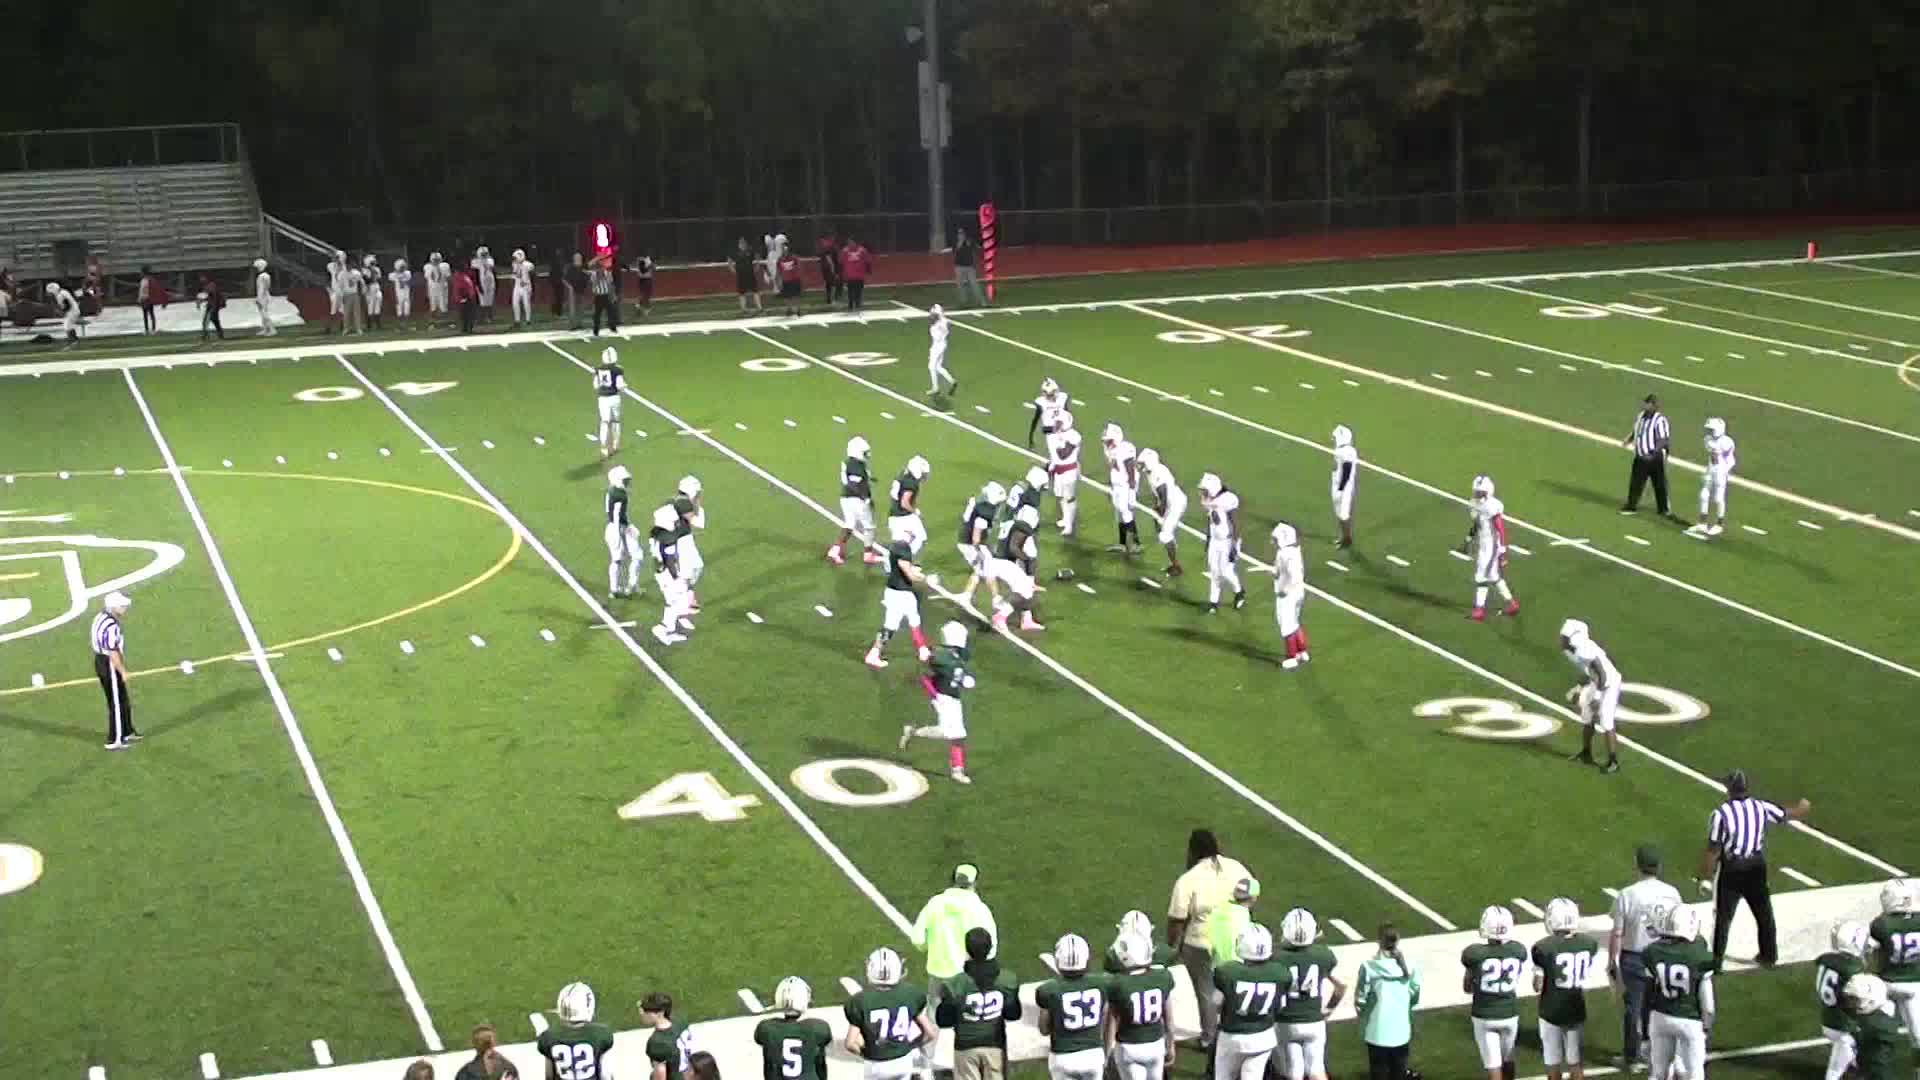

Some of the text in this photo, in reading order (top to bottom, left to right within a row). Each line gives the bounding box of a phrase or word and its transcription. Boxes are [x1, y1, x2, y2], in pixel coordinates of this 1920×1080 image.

[1412, 681, 1710, 740] 30
[618, 758, 929, 823] 40
[1288, 963, 1319, 998] 14
[1480, 958, 1522, 993] 23
[1555, 951, 1593, 989] 30
[1656, 962, 1690, 998] 19
[1816, 965, 1839, 1007] 16
[1062, 988, 1101, 1030] 53
[1129, 988, 1163, 1025] 18
[1235, 981, 1276, 1016] 77
[870, 1006, 912, 1044] 74
[551, 1043, 595, 1080] 22
[782, 1038, 803, 1077] 5
